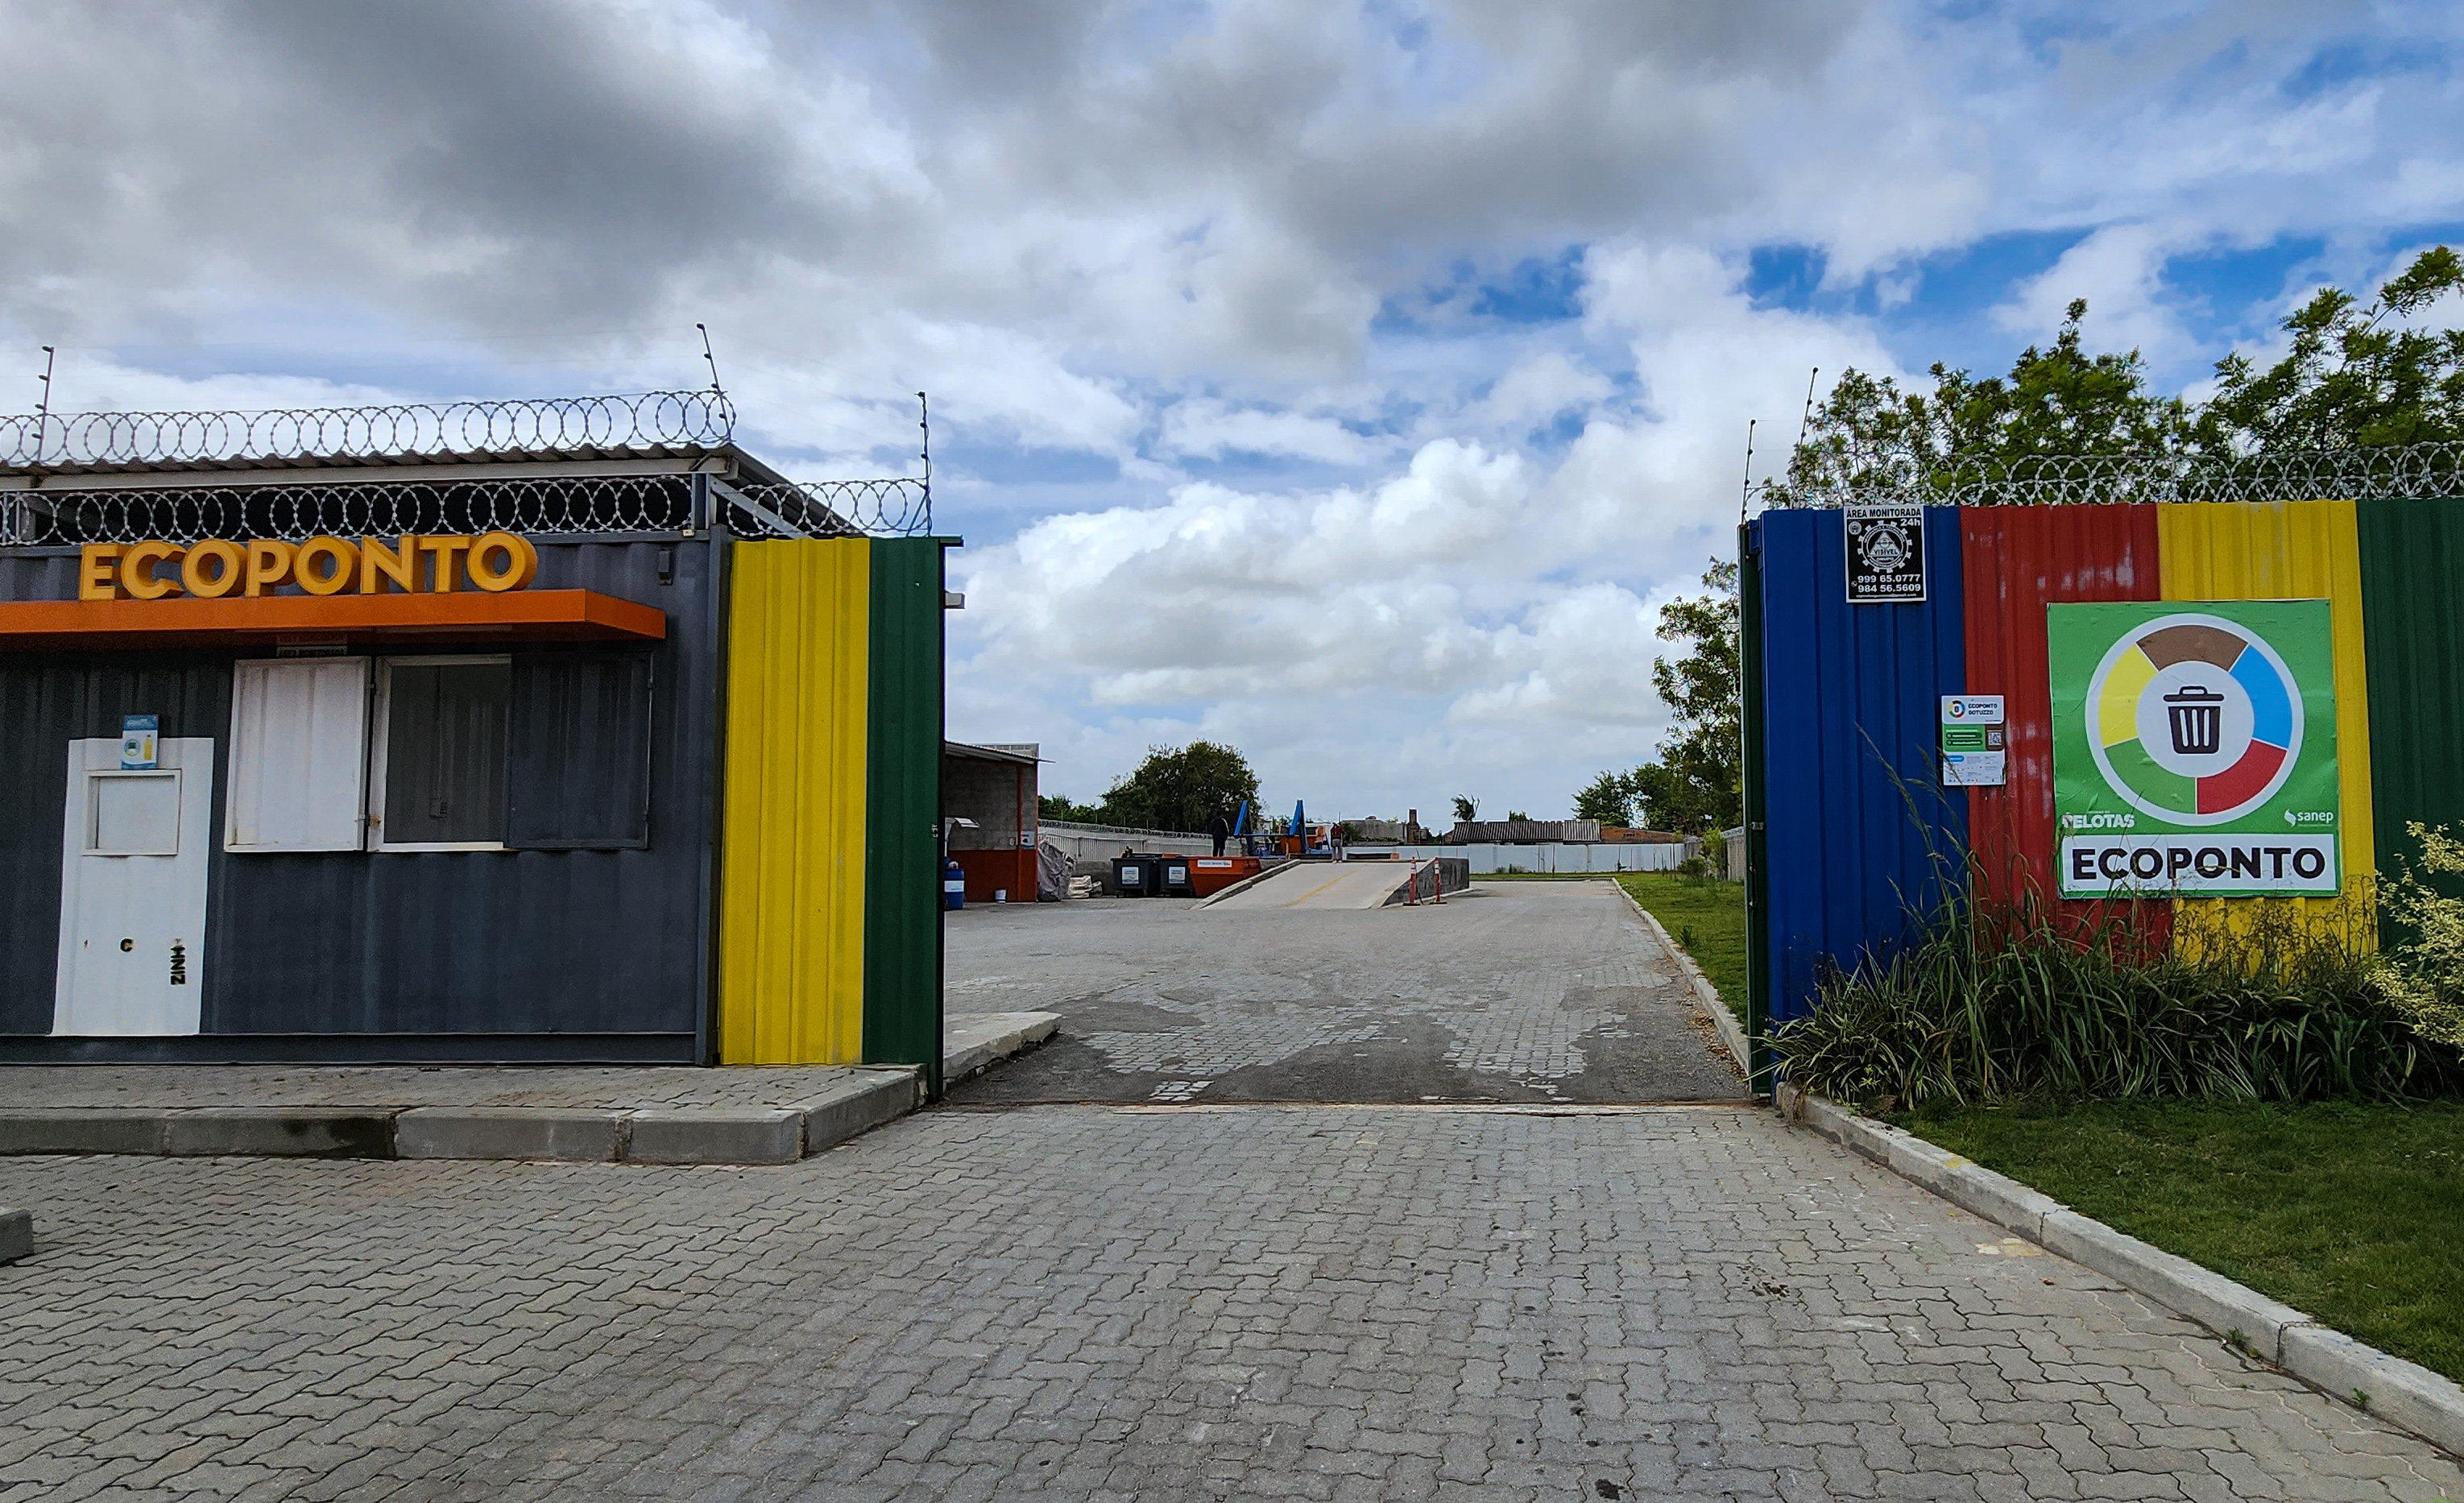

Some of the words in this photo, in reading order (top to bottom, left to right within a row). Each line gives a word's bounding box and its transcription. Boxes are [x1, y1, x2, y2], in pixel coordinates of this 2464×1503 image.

[1847, 508, 1867, 518] ÁREA
[1870, 508, 1921, 517] MONITORADA
[79, 532, 538, 601] ECOPONTO
[1857, 575, 1877, 583] 999
[1879, 574, 1921, 582] 65.0777
[1857, 585, 1878, 593] 984
[1879, 584, 1921, 592] 56.5609
[2297, 810, 2334, 824] sanep
[2073, 847, 2326, 880] ECOPONTO
